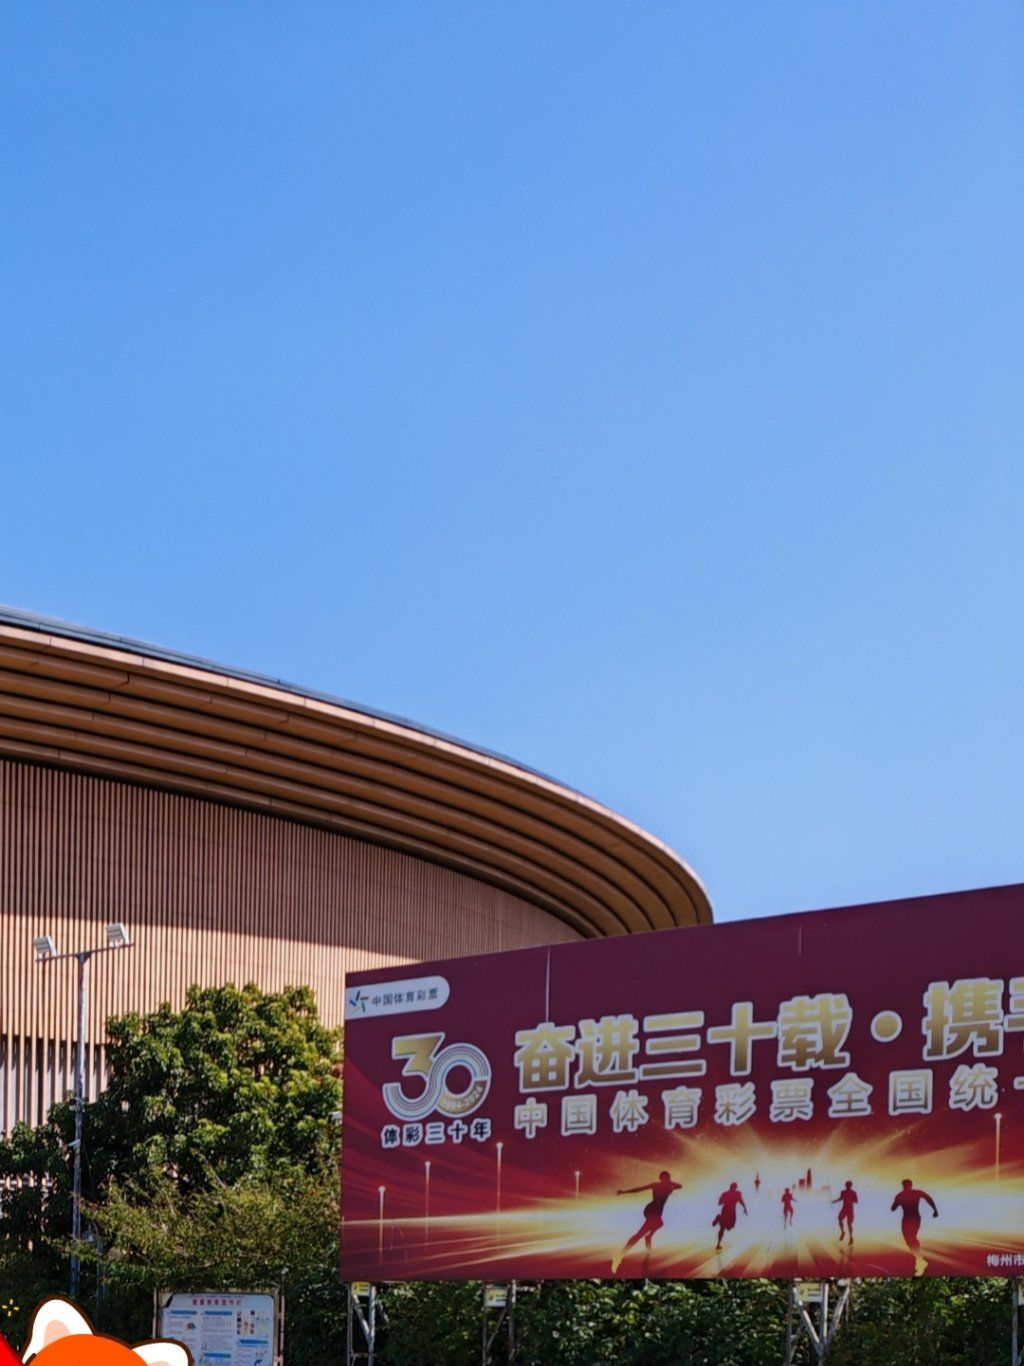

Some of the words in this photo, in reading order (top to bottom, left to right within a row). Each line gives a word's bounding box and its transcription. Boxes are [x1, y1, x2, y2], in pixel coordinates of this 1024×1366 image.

[372, 987, 439, 1007] 中国体育彩票
[514, 977, 1024, 1093] 奋进三十载·携
[382, 1032, 492, 1121] 30
[514, 1062, 1024, 1138] 中国体育彩票全国统
[382, 1118, 491, 1148] 体彩三十年
